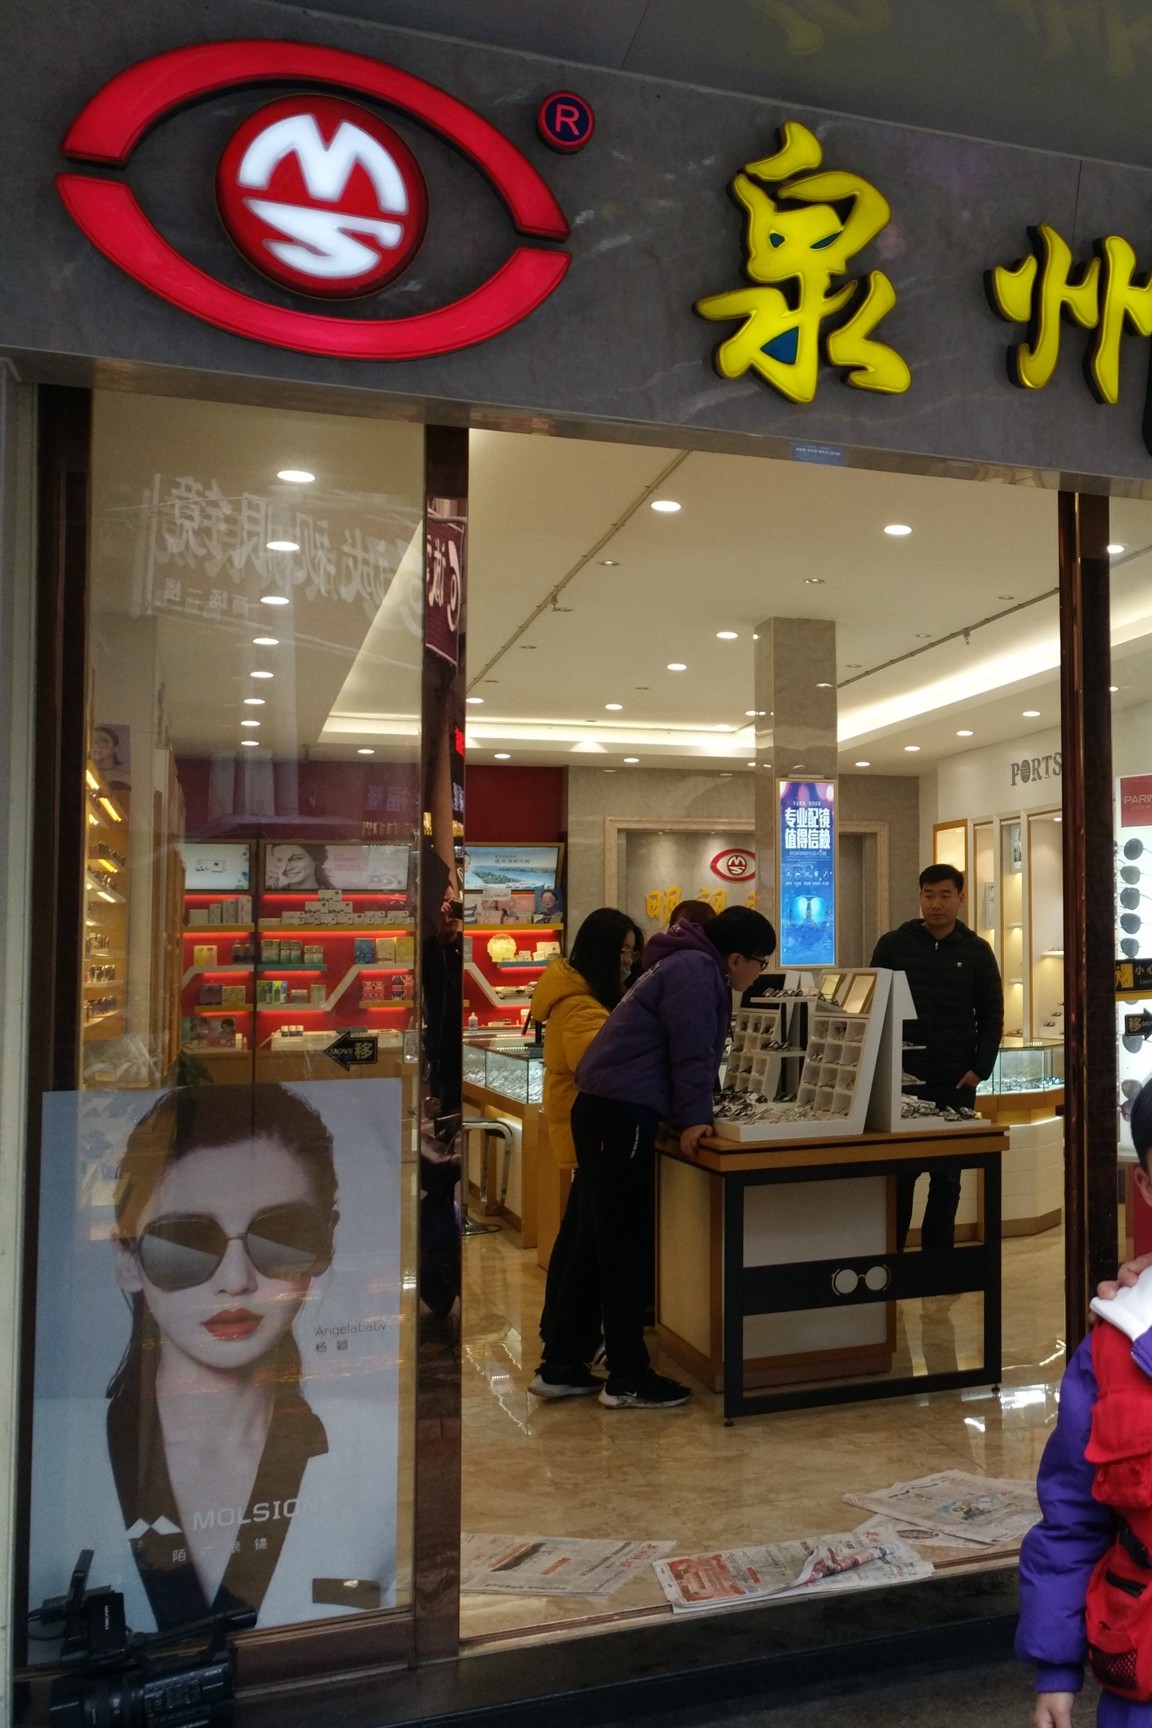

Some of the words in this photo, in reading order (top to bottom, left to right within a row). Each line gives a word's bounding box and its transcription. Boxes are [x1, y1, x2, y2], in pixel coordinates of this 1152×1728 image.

[785, 807, 831, 828] 专业配镜
[785, 829, 831, 849] 值得信赖
[1128, 1018, 1141, 1032] 移
[354, 1042, 373, 1059] 移
[315, 1320, 388, 1338] Angelababy
